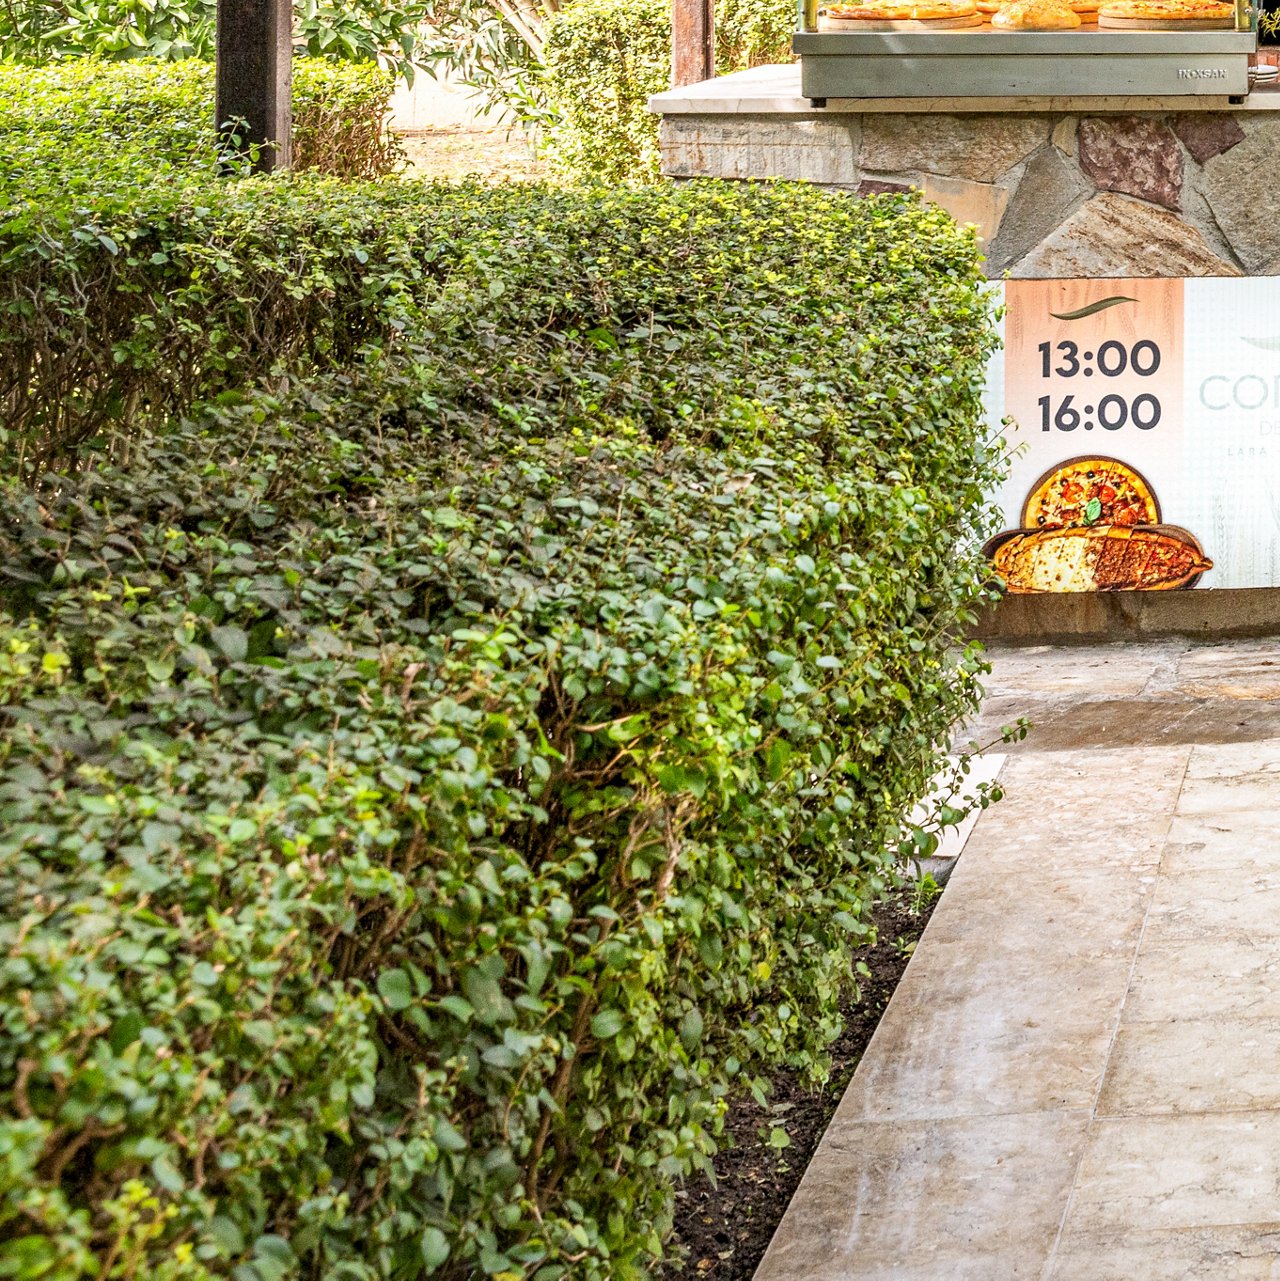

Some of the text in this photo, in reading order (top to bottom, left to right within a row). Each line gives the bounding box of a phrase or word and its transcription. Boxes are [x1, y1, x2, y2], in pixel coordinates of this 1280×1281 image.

[1037, 339, 1162, 379] 13:00
[1037, 392, 1162, 433] 16:00
[1227, 446, 1268, 457] LARA
